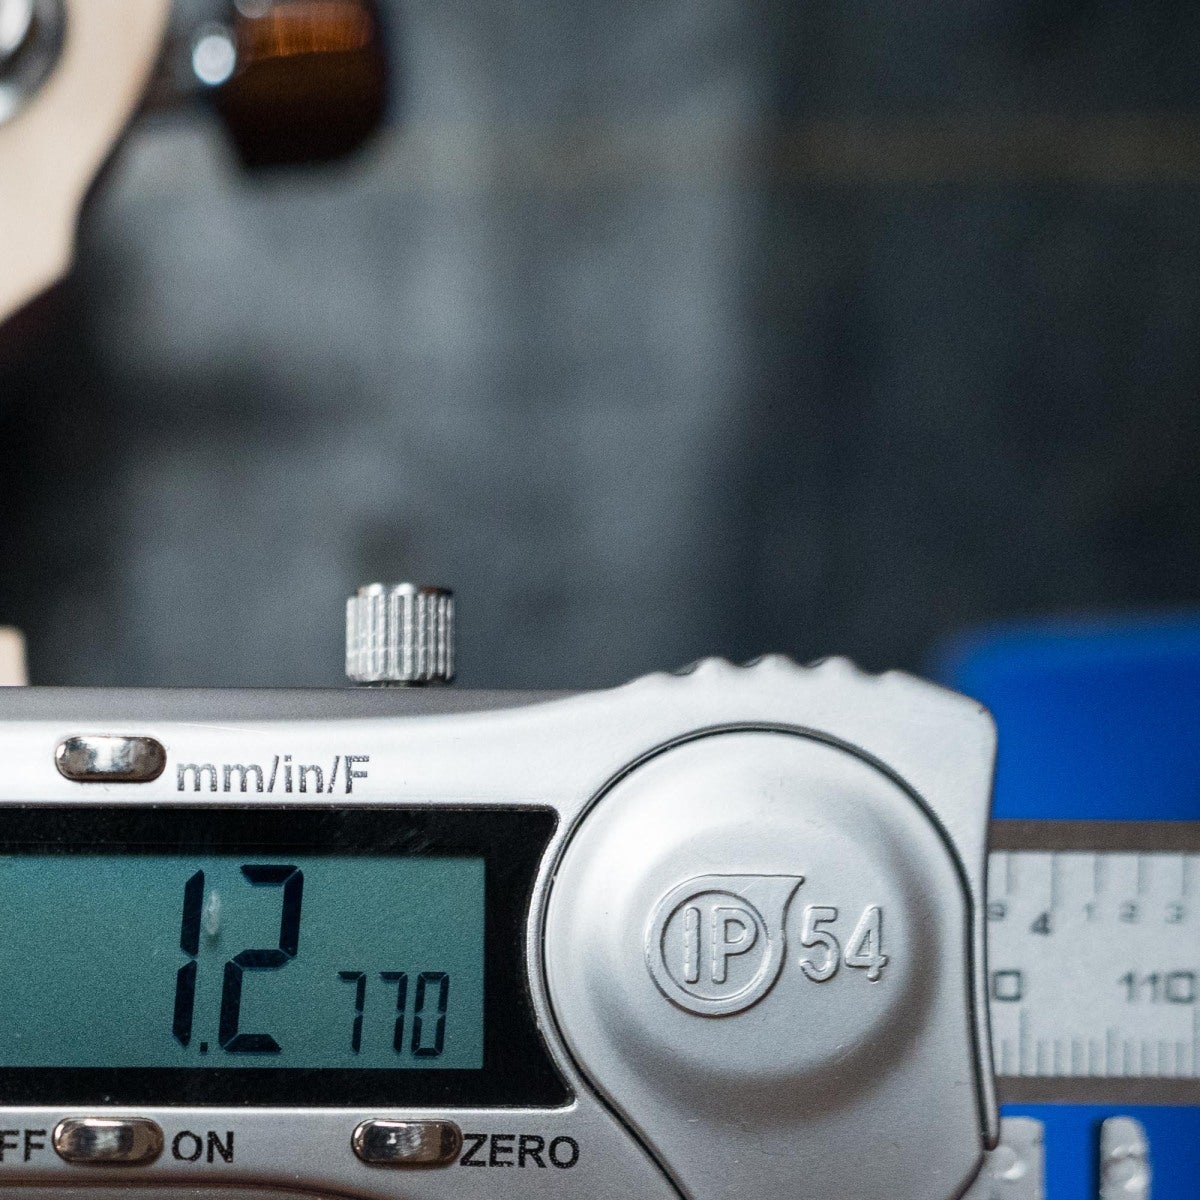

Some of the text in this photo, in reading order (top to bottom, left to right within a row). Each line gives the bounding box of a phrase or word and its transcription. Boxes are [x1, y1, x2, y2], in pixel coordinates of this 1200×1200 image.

[176, 755, 370, 795] mm/in/F
[1029, 911, 1052, 935] 4
[684, 904, 889, 984] IP 54
[1119, 970, 1196, 1004] 110
[172, 1130, 235, 1164] ON
[458, 1133, 580, 1171] ZERO
